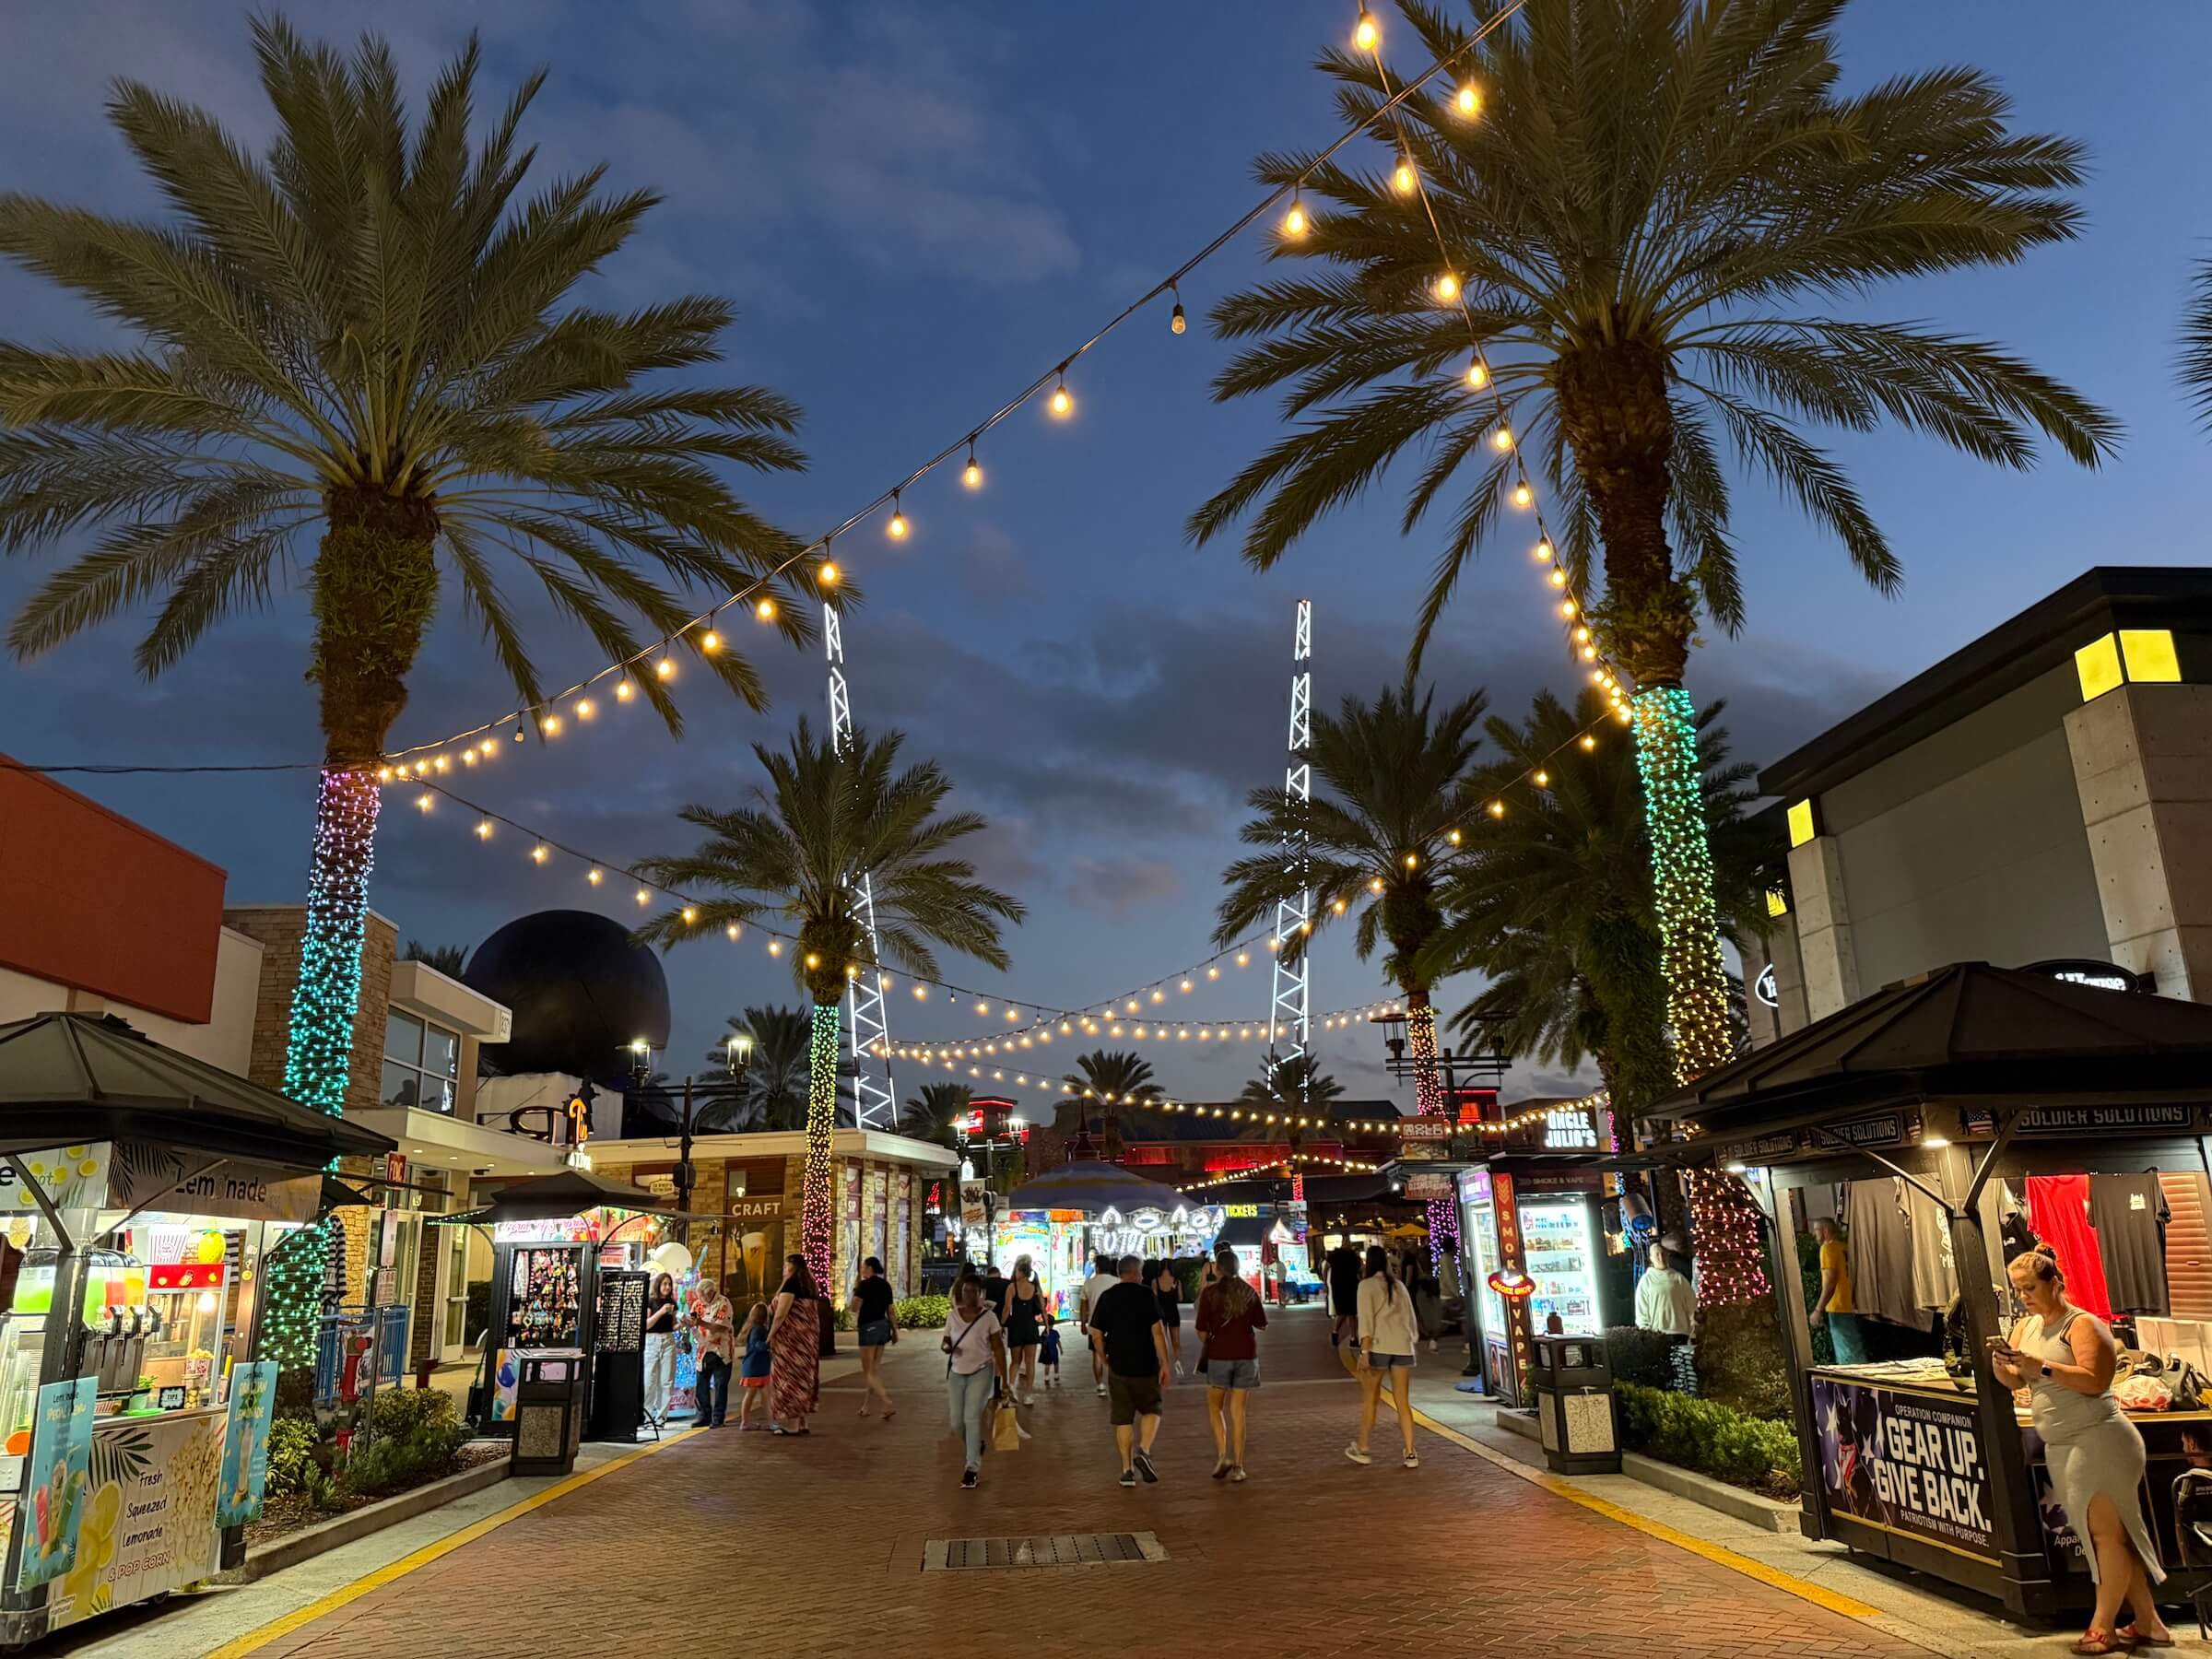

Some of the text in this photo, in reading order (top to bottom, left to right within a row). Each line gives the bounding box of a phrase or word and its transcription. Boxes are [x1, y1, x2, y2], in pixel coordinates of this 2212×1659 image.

[1547, 1112, 1590, 1130] UNCLE
[2093, 1106, 2183, 1124] SOLUTIONS
[1545, 1129, 1598, 1148] JULIO'S
[1852, 1120, 1896, 1141] SOLUTIONS
[1759, 1135, 1794, 1154] SOLUTIONS
[388, 1161, 404, 1182] FDC
[732, 1202, 781, 1216] CRAFT
[1224, 1204, 1258, 1218] TICKETS
[1512, 1308, 1528, 1371] VAPE
[1895, 1403, 1972, 1430] OPERATION COMPANION
[1886, 1416, 1985, 1481] GEAR UP.
[139, 1468, 164, 1488] Fresh
[1873, 1458, 1992, 1534] GIVE BACK.
[125, 1493, 168, 1523] Squeezed
[122, 1523, 164, 1548] Lemonade
[1900, 1509, 1990, 1548] PATRIOTISM WITH PURPOSE.
[117, 1559, 141, 1580] POP
[141, 1549, 172, 1571] CORN
